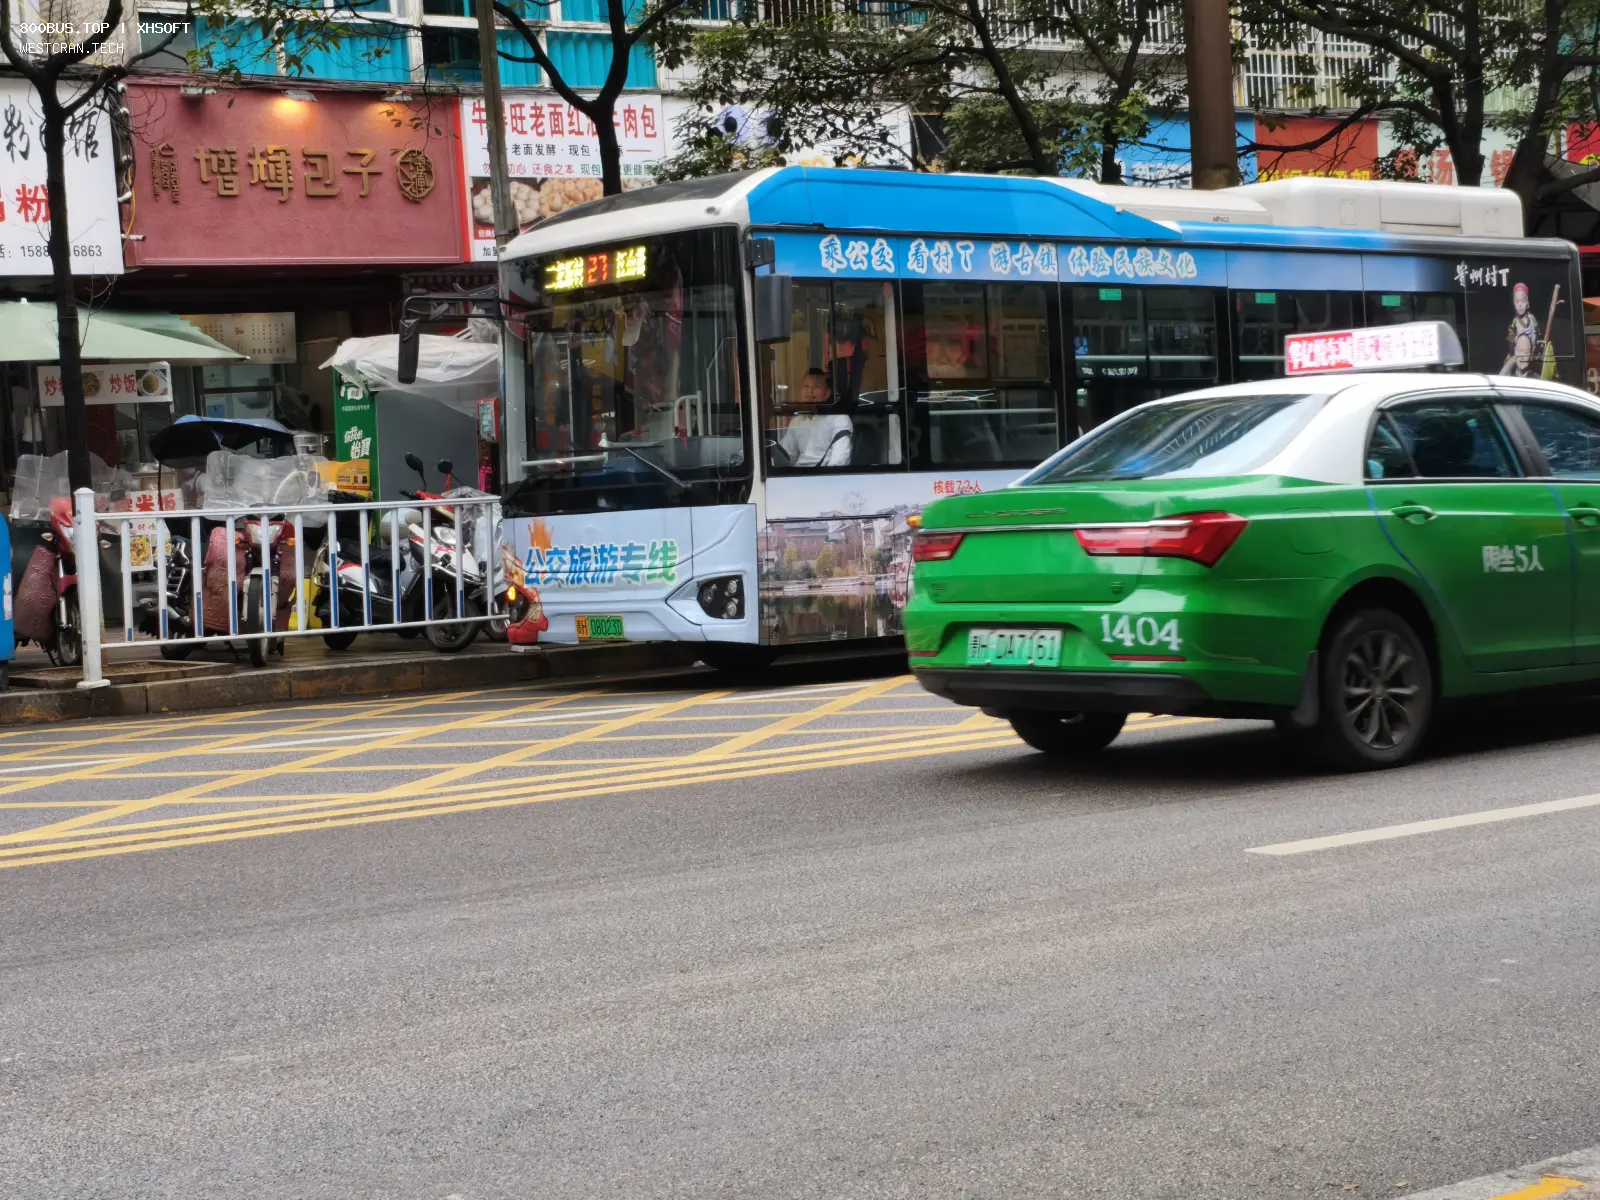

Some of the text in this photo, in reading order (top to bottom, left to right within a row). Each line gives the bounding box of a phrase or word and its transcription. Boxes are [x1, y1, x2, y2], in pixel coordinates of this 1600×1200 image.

[482, 162, 526, 175] 勿初心
[587, 253, 608, 283] 27
[818, 234, 895, 273] 乘公交
[988, 240, 1057, 276] 游古镇
[1067, 246, 1198, 279] 体验民族文化
[109, 373, 137, 393] 炒饭
[933, 480, 983, 494] 核载72人
[524, 540, 678, 586] 公交旅游专线
[1100, 613, 1184, 651] 1404
